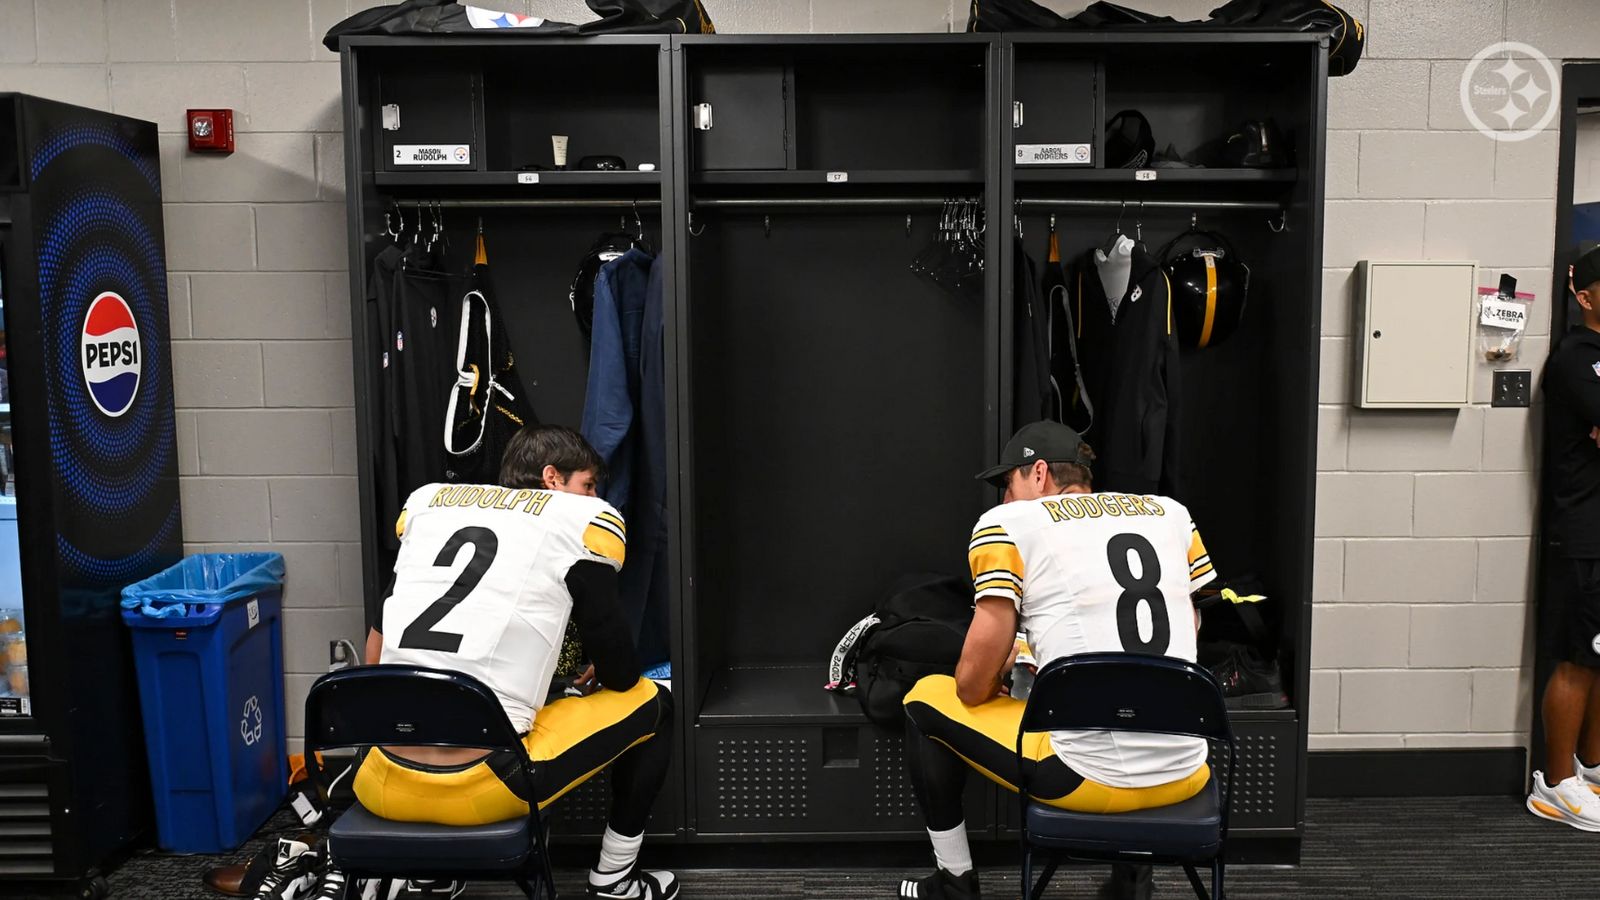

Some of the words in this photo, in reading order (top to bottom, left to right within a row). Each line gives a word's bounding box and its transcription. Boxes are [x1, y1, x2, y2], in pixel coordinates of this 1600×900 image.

[396, 150, 401, 158] 2
[1017, 149, 1023, 158] 8
[1034, 152, 1068, 160] RODGERS
[1496, 309, 1524, 319] ZEBRA
[86, 340, 138, 369] PEPSI
[428, 485, 553, 516] RUDOLPH
[1042, 494, 1165, 522] RODGERS
[398, 525, 499, 654] 2
[1107, 532, 1171, 655] 8
